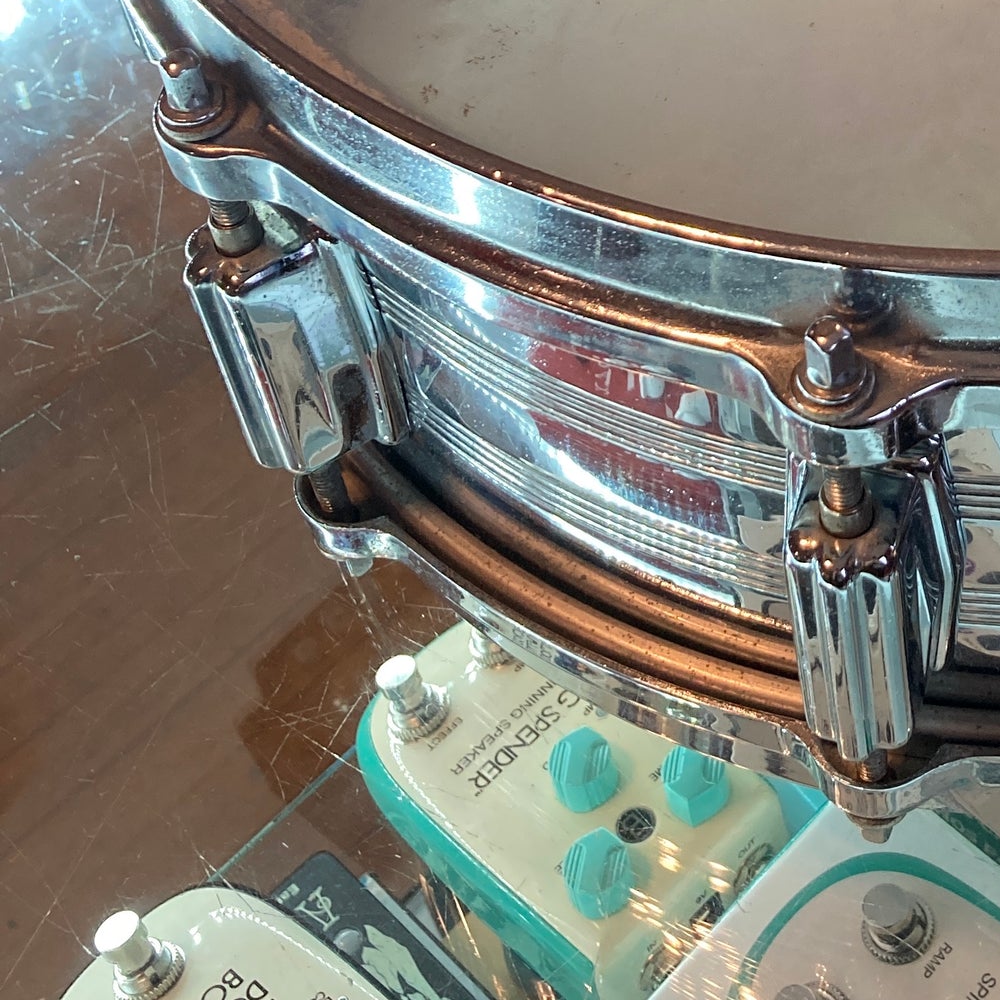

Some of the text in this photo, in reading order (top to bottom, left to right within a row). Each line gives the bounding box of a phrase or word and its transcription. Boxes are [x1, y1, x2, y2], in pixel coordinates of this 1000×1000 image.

[427, 717, 463, 752] EFFECT
[451, 719, 511, 775] SPEAKER
[923, 942, 953, 979] RAMP
